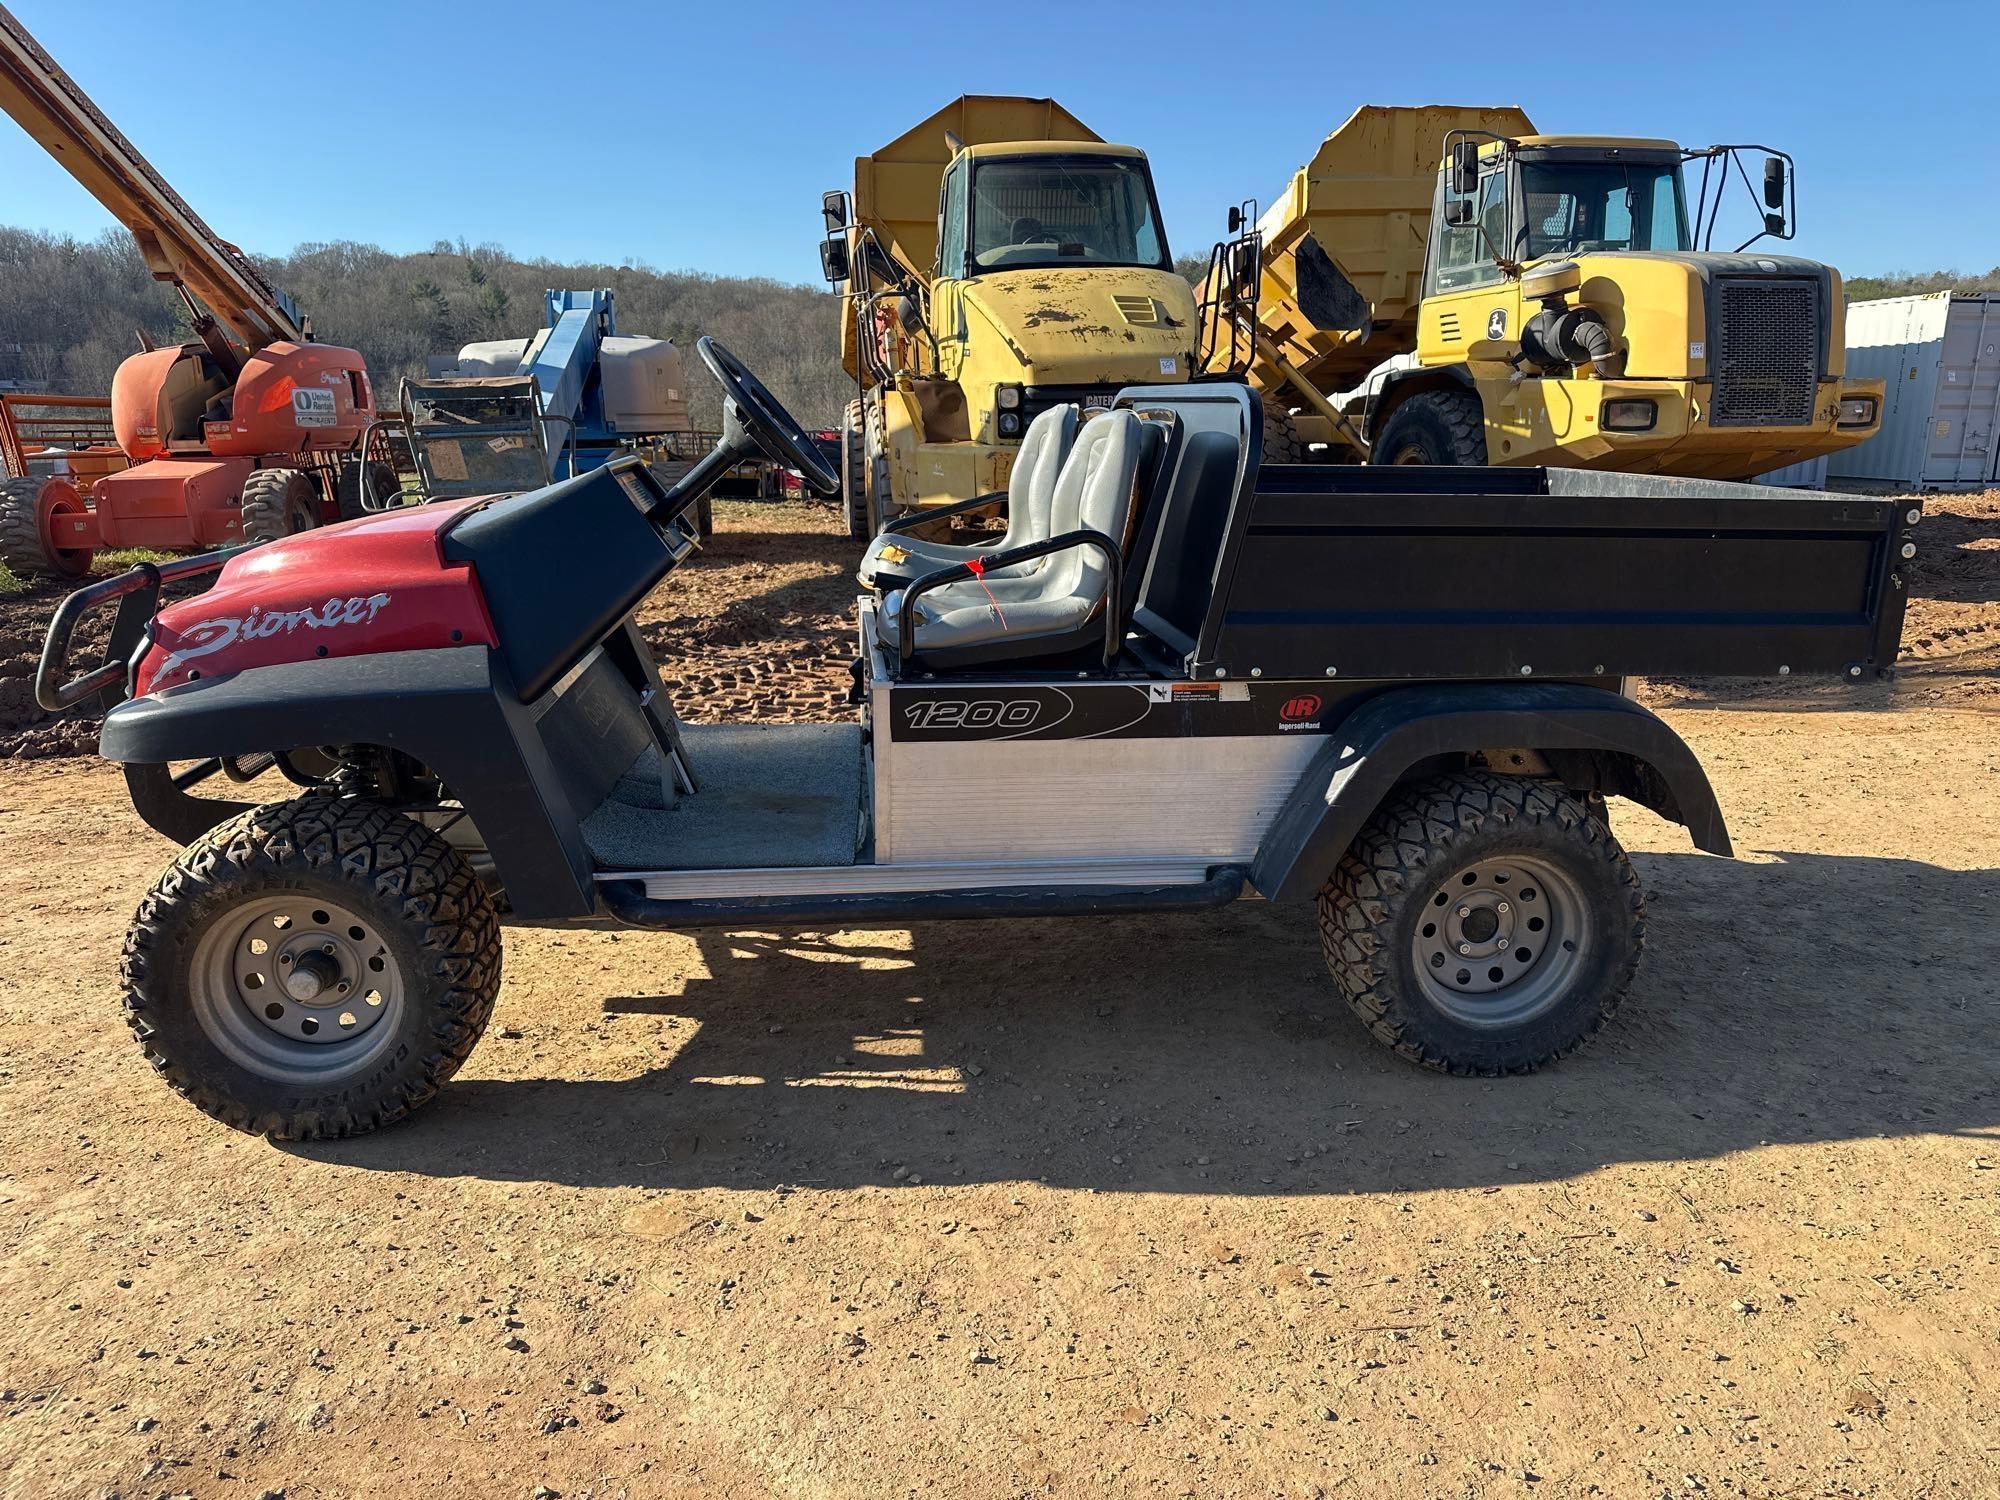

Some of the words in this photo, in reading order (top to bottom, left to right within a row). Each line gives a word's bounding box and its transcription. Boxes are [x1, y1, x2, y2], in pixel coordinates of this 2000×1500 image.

[313, 401, 334, 410] Rentals
[1087, 395, 1116, 406] CATER
[147, 592, 392, 692] Pioneer
[904, 700, 1042, 728] 1200
[1285, 699, 1314, 716] IR
[1278, 722, 1321, 730] Ingersoll-Rand
